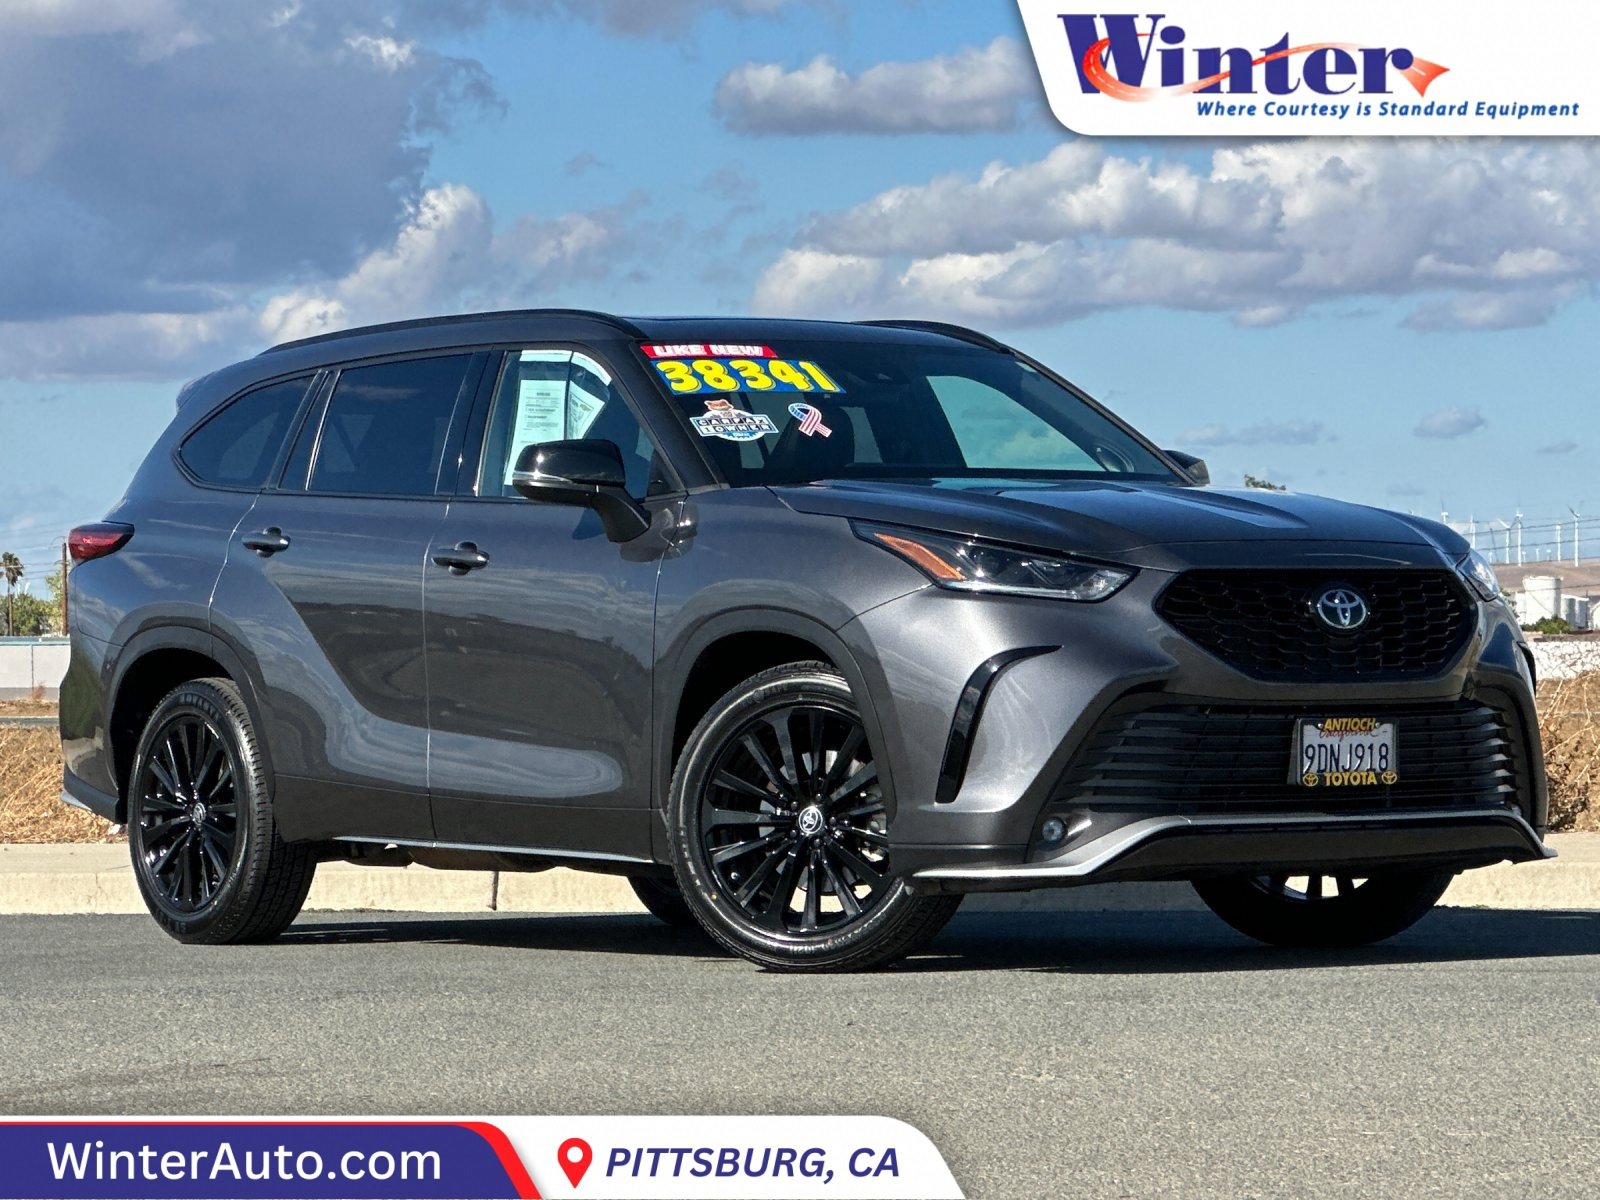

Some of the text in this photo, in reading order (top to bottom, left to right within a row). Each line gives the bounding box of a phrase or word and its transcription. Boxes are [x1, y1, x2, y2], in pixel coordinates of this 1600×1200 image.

[652, 345, 764, 357] LIKE NEW
[656, 359, 841, 392] 38341
[698, 417, 767, 425] CARFAX
[1324, 717, 1376, 730] ANTIOCH
[1303, 742, 1389, 774] 9DNJ918
[1324, 771, 1378, 786] TOYOTA
